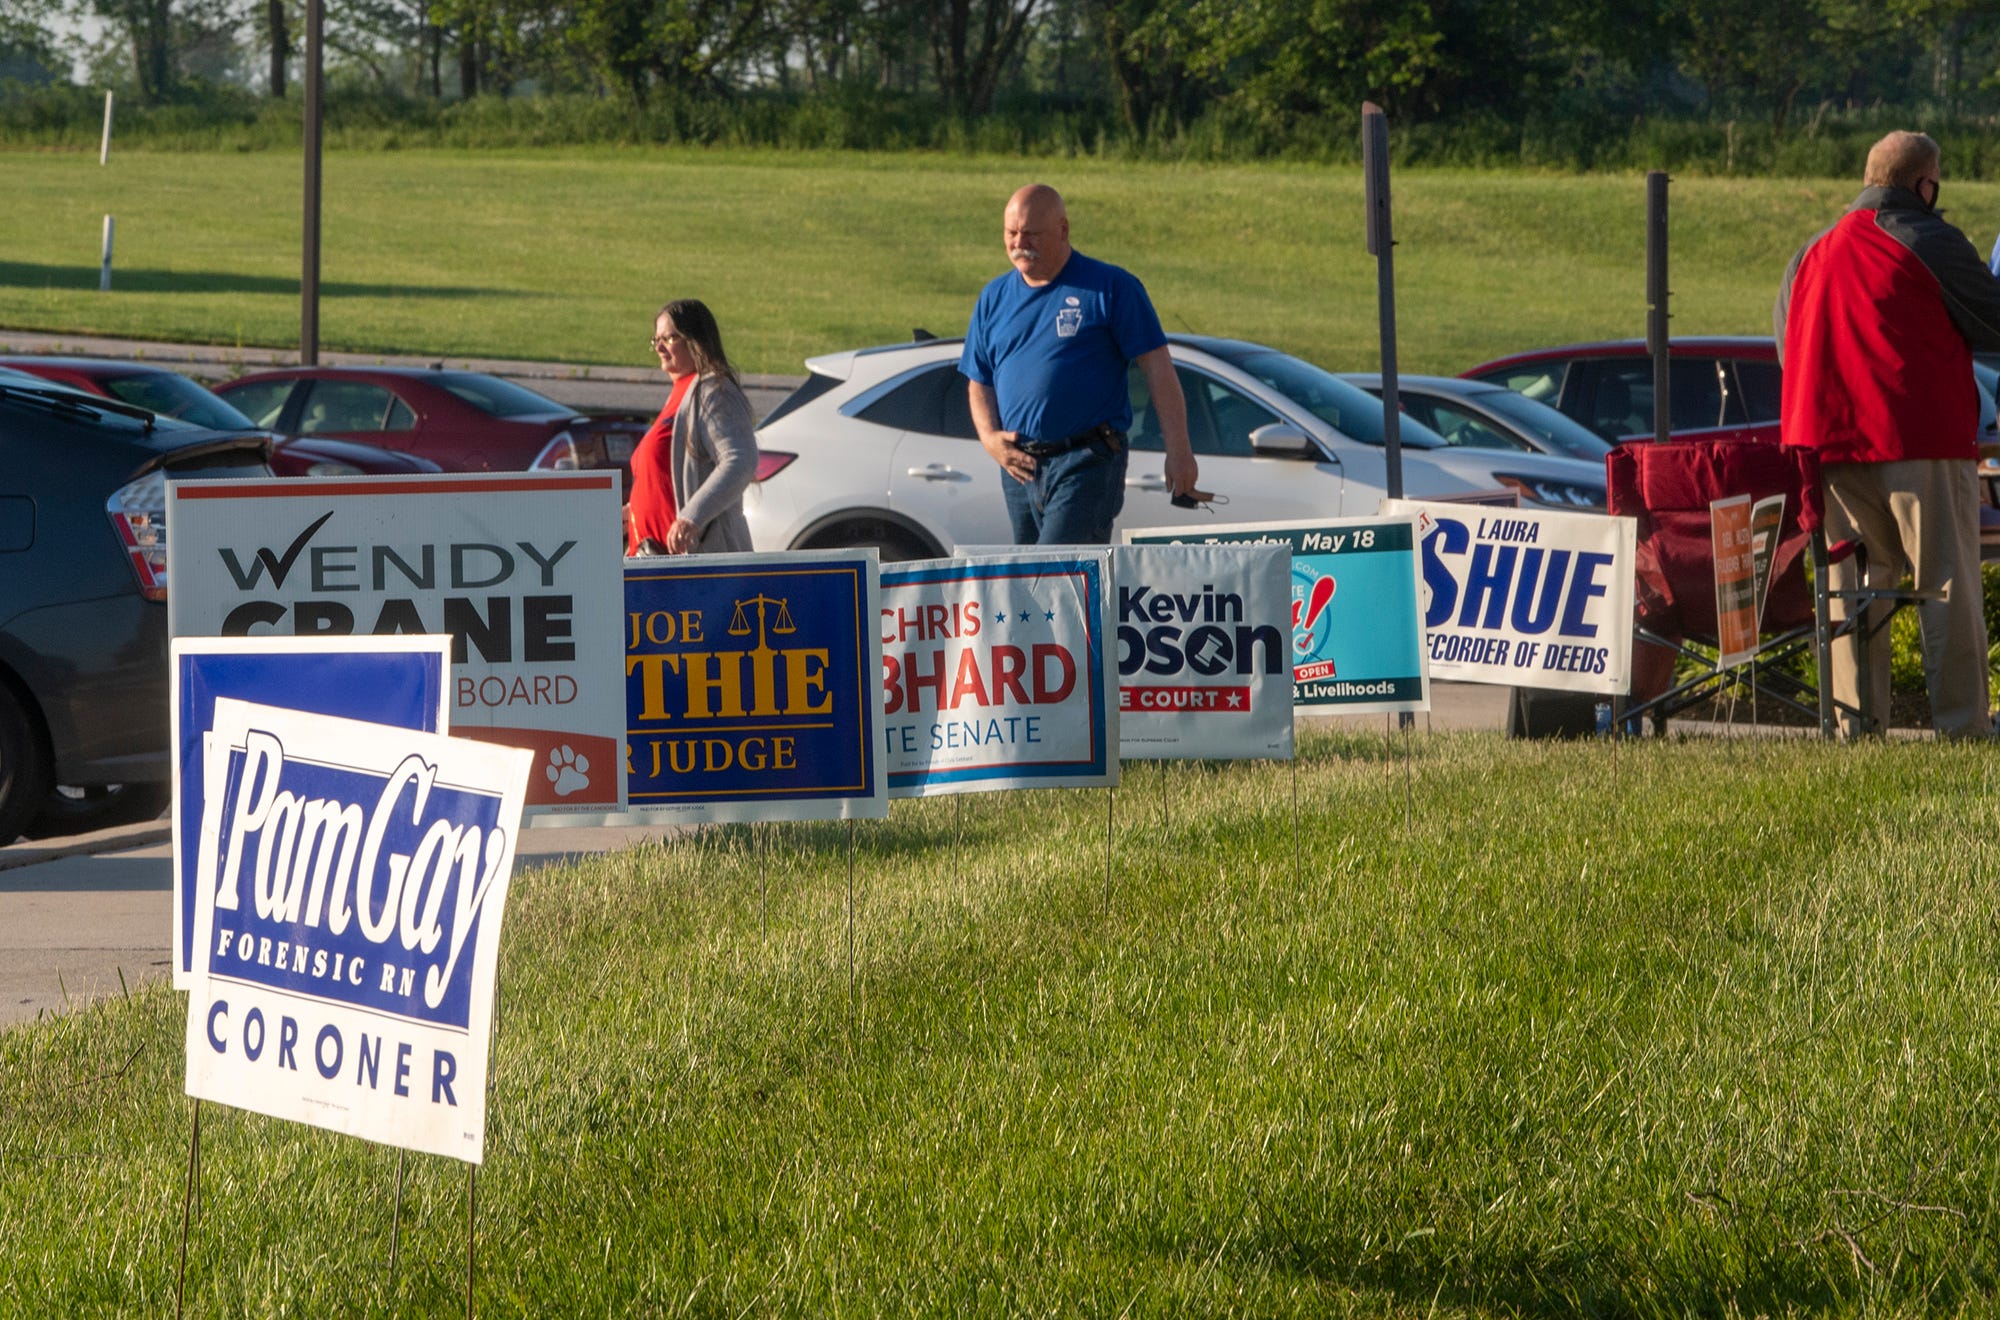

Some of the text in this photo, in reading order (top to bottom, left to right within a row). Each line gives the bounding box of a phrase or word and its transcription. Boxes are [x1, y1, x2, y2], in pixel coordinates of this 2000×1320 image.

[1301, 532, 1345, 553] May
[1351, 530, 1375, 549] 18
[1476, 518, 1540, 543] LAURA
[217, 511, 578, 592] WENDY
[1421, 518, 1615, 638] SHUE
[881, 601, 981, 644] CHRIS
[1119, 584, 1243, 622] Kevin
[628, 609, 704, 649] JOE
[1300, 665, 1329, 678] OPEN
[1513, 641, 1541, 668] OF
[1542, 643, 1609, 675] DEEDS
[457, 675, 578, 708] BOARD
[626, 648, 833, 720] THIE
[882, 643, 1077, 715] BHARD
[1304, 681, 1396, 698] Livelihoods
[1140, 691, 1219, 707] COURT
[930, 716, 1042, 750] SENATE
[648, 737, 797, 778] JUDGE
[216, 929, 417, 998] FORENSIC RN
[206, 999, 458, 1107] CORONER
